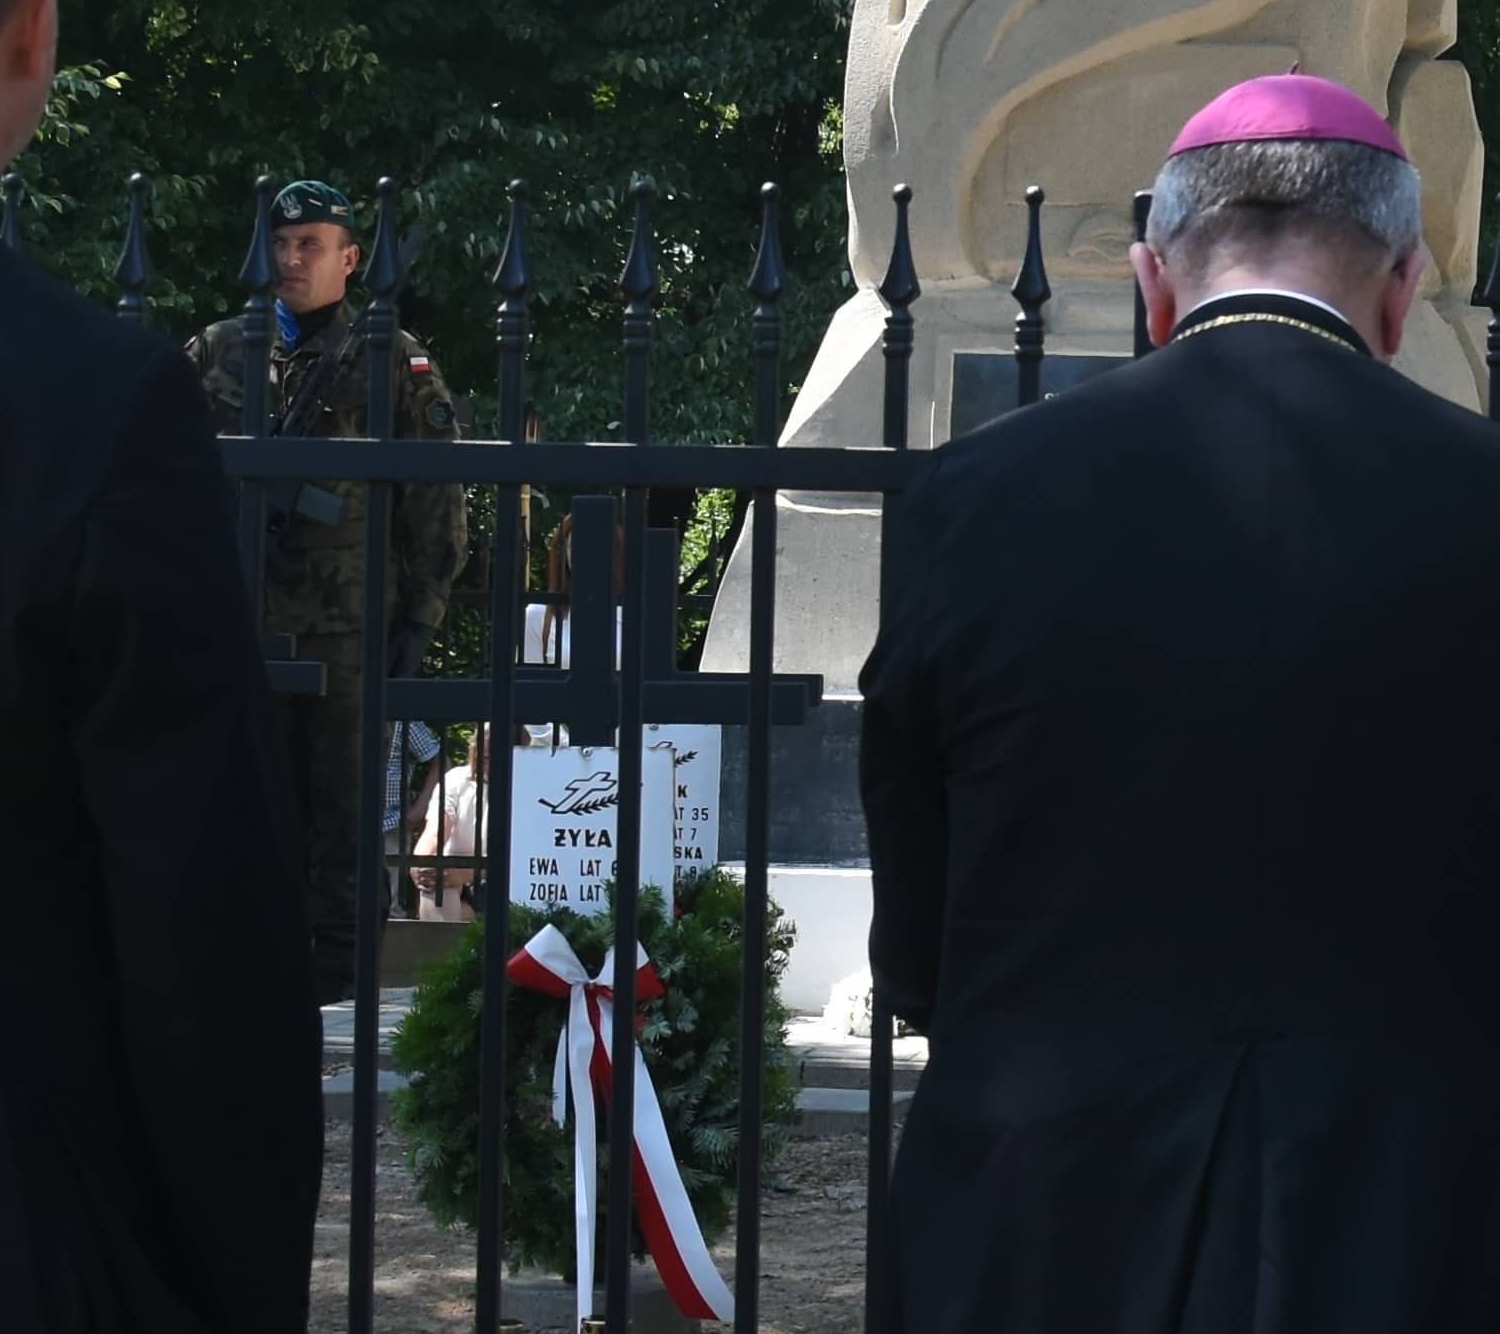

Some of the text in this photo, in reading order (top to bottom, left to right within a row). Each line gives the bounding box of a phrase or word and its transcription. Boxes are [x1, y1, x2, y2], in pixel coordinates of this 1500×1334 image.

[691, 808, 709, 822] 35
[554, 828, 612, 848] ŻYŁA
[690, 828, 697, 840] 7
[530, 858, 559, 876] EWA
[580, 859, 602, 877] LAT
[580, 884, 601, 902] LAT
